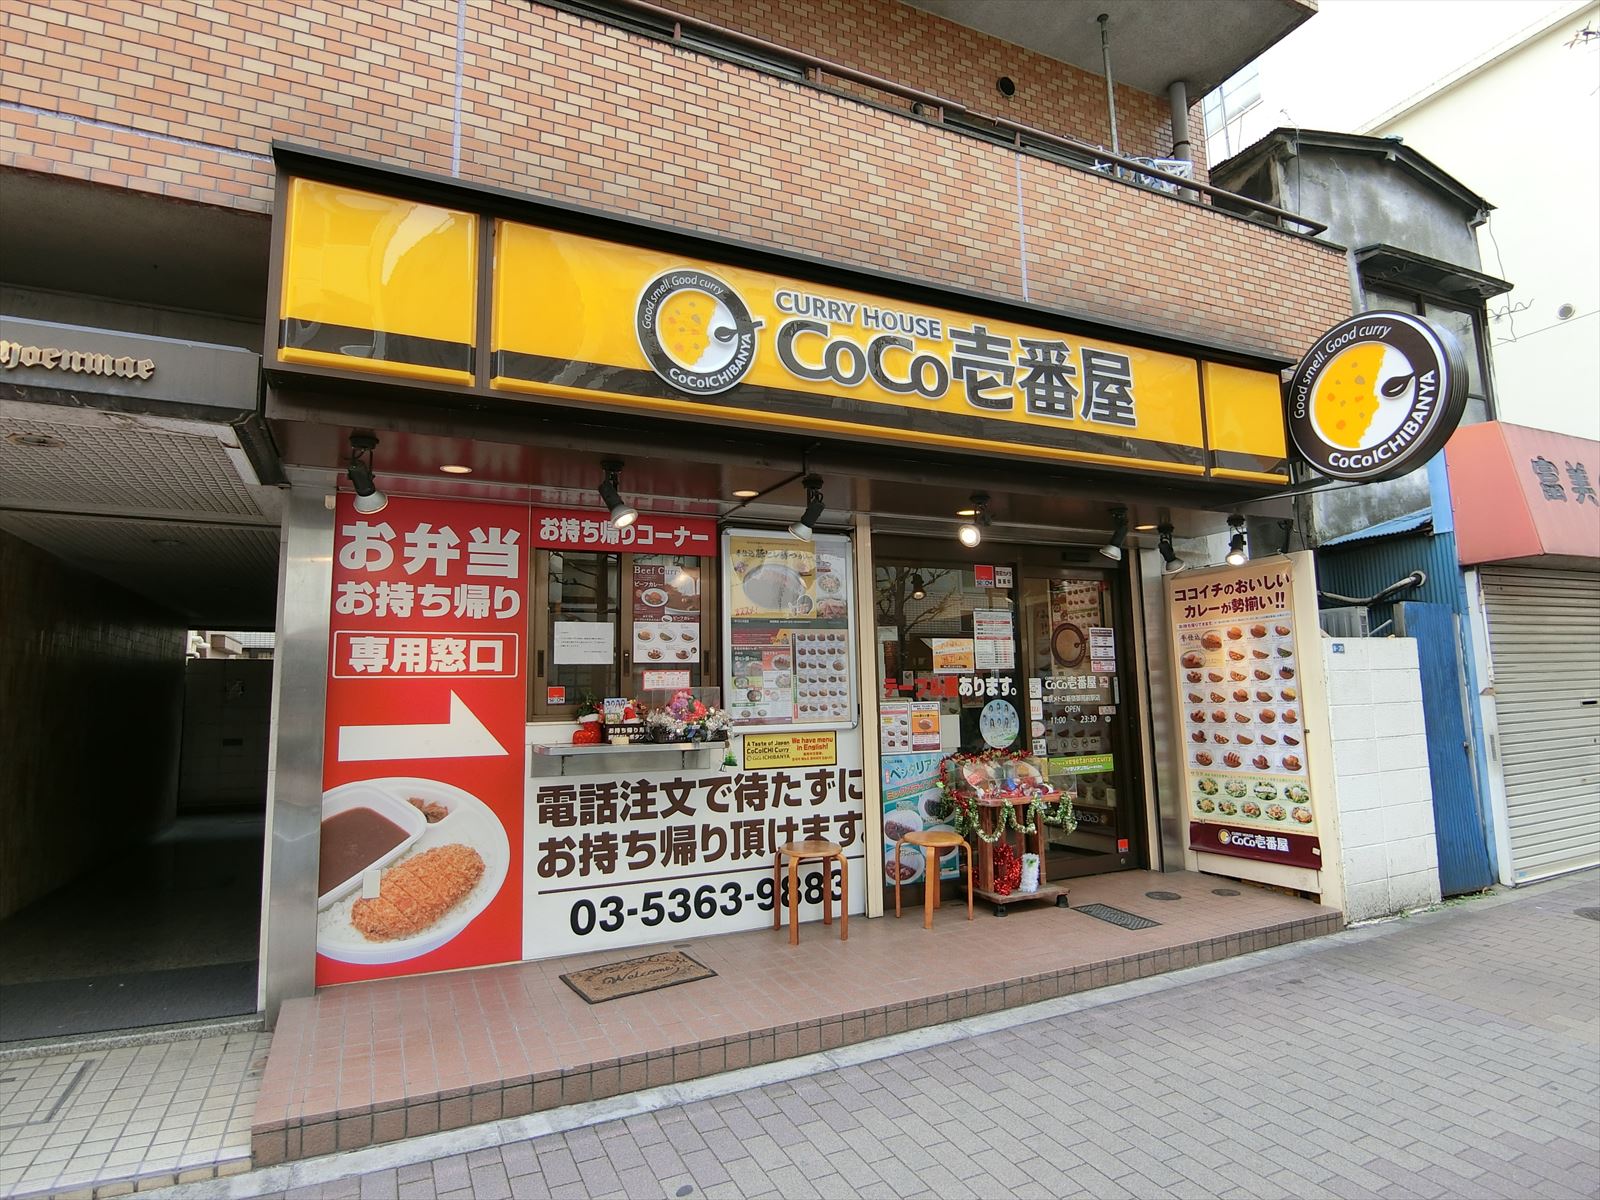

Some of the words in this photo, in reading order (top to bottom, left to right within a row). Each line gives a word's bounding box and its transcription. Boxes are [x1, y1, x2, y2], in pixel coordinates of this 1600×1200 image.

[642, 298, 656, 330] Good
[671, 275, 698, 286] Good
[699, 279, 724, 295] curry
[776, 291, 856, 323] CURRY
[863, 307, 942, 340] HOUSE
[777, 319, 1136, 426] CoCo壱番屋
[1294, 385, 1308, 419] Good
[1325, 325, 1357, 354] Good
[1358, 324, 1392, 339] curry
[338, 521, 520, 579] お弁当
[539, 517, 709, 548] お持ち帰りコーナー
[634, 566, 656, 575] Beef
[1174, 574, 1290, 602] ココイチのおいしい
[335, 581, 521, 620] お持ち帰り
[348, 636, 504, 673] 専用窓口
[1050, 716, 1067, 725] 11:00
[1080, 714, 1097, 724] 23:30
[1064, 705, 1081, 713] OPEN
[536, 768, 862, 828] 電話注文で待たずに
[602, 965, 675, 985] Welcome
